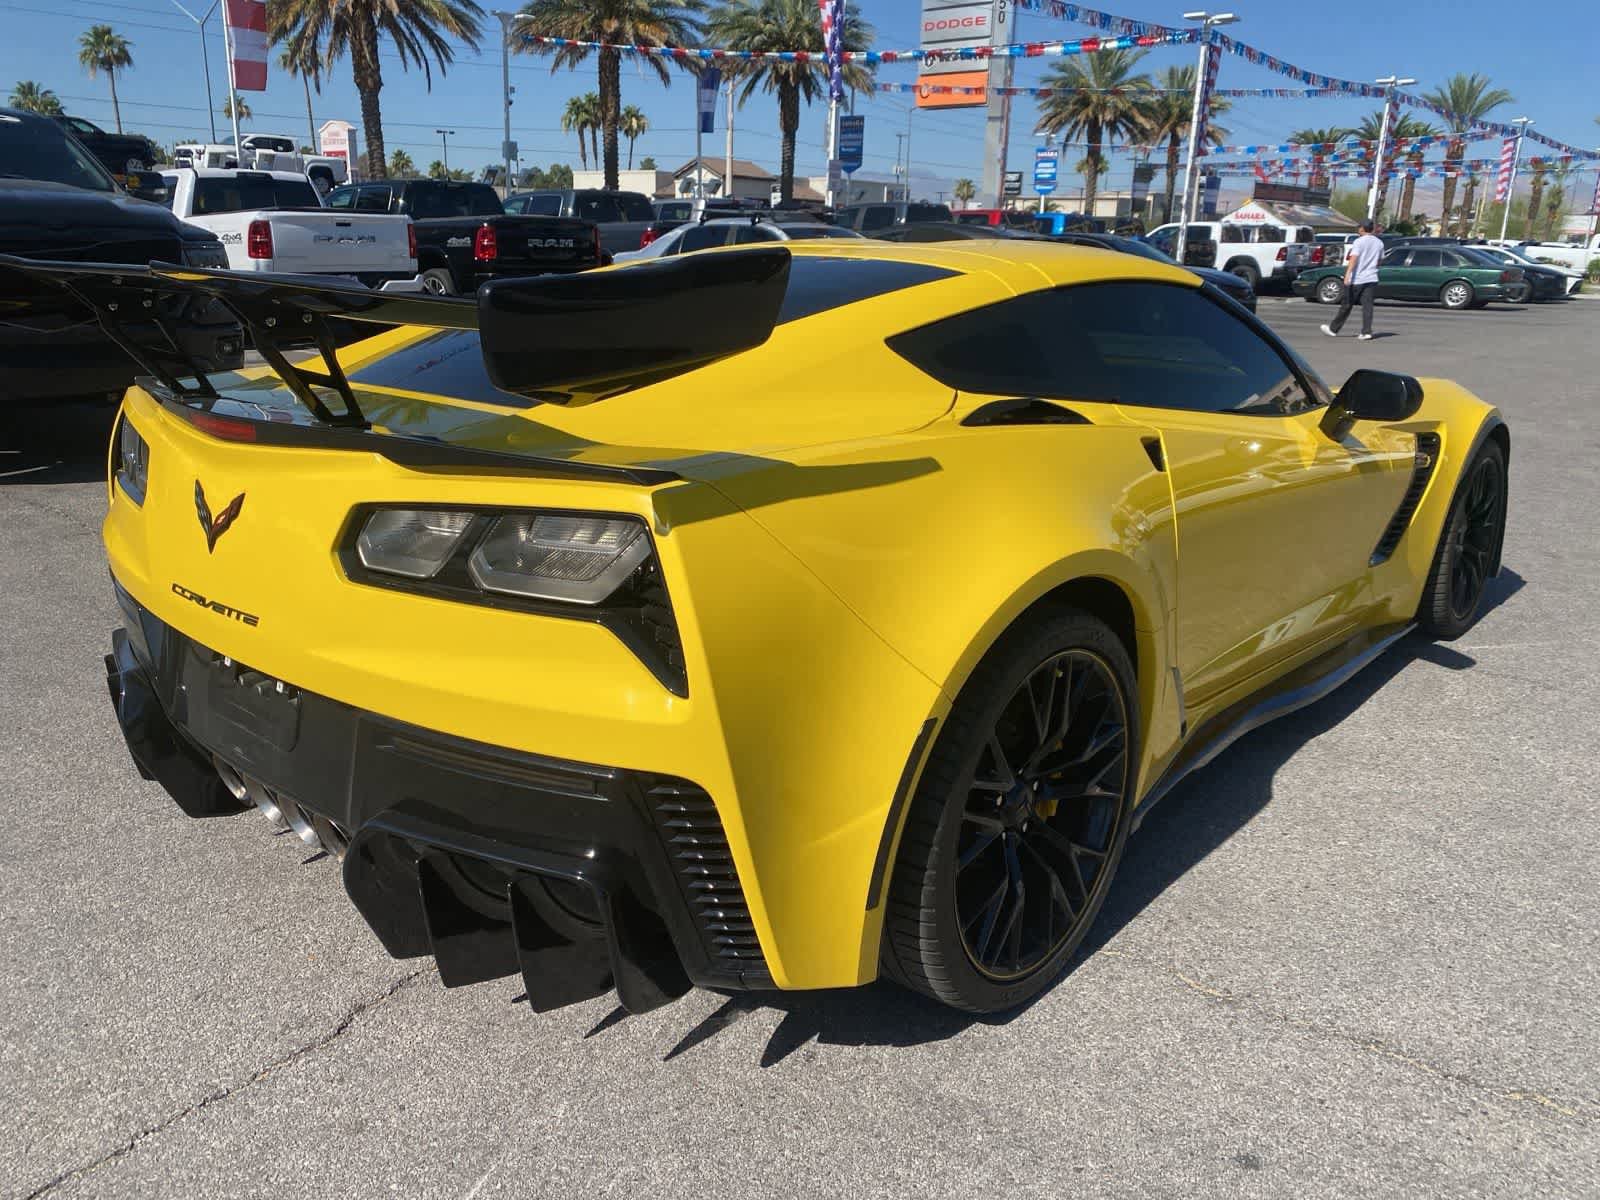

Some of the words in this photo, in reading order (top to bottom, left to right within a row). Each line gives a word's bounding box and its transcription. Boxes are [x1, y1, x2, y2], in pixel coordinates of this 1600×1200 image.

[924, 16, 987, 32] DODGE
[221, 232, 242, 240] 4x4
[527, 238, 574, 248] RAM
[172, 582, 260, 628] CORVETTE
